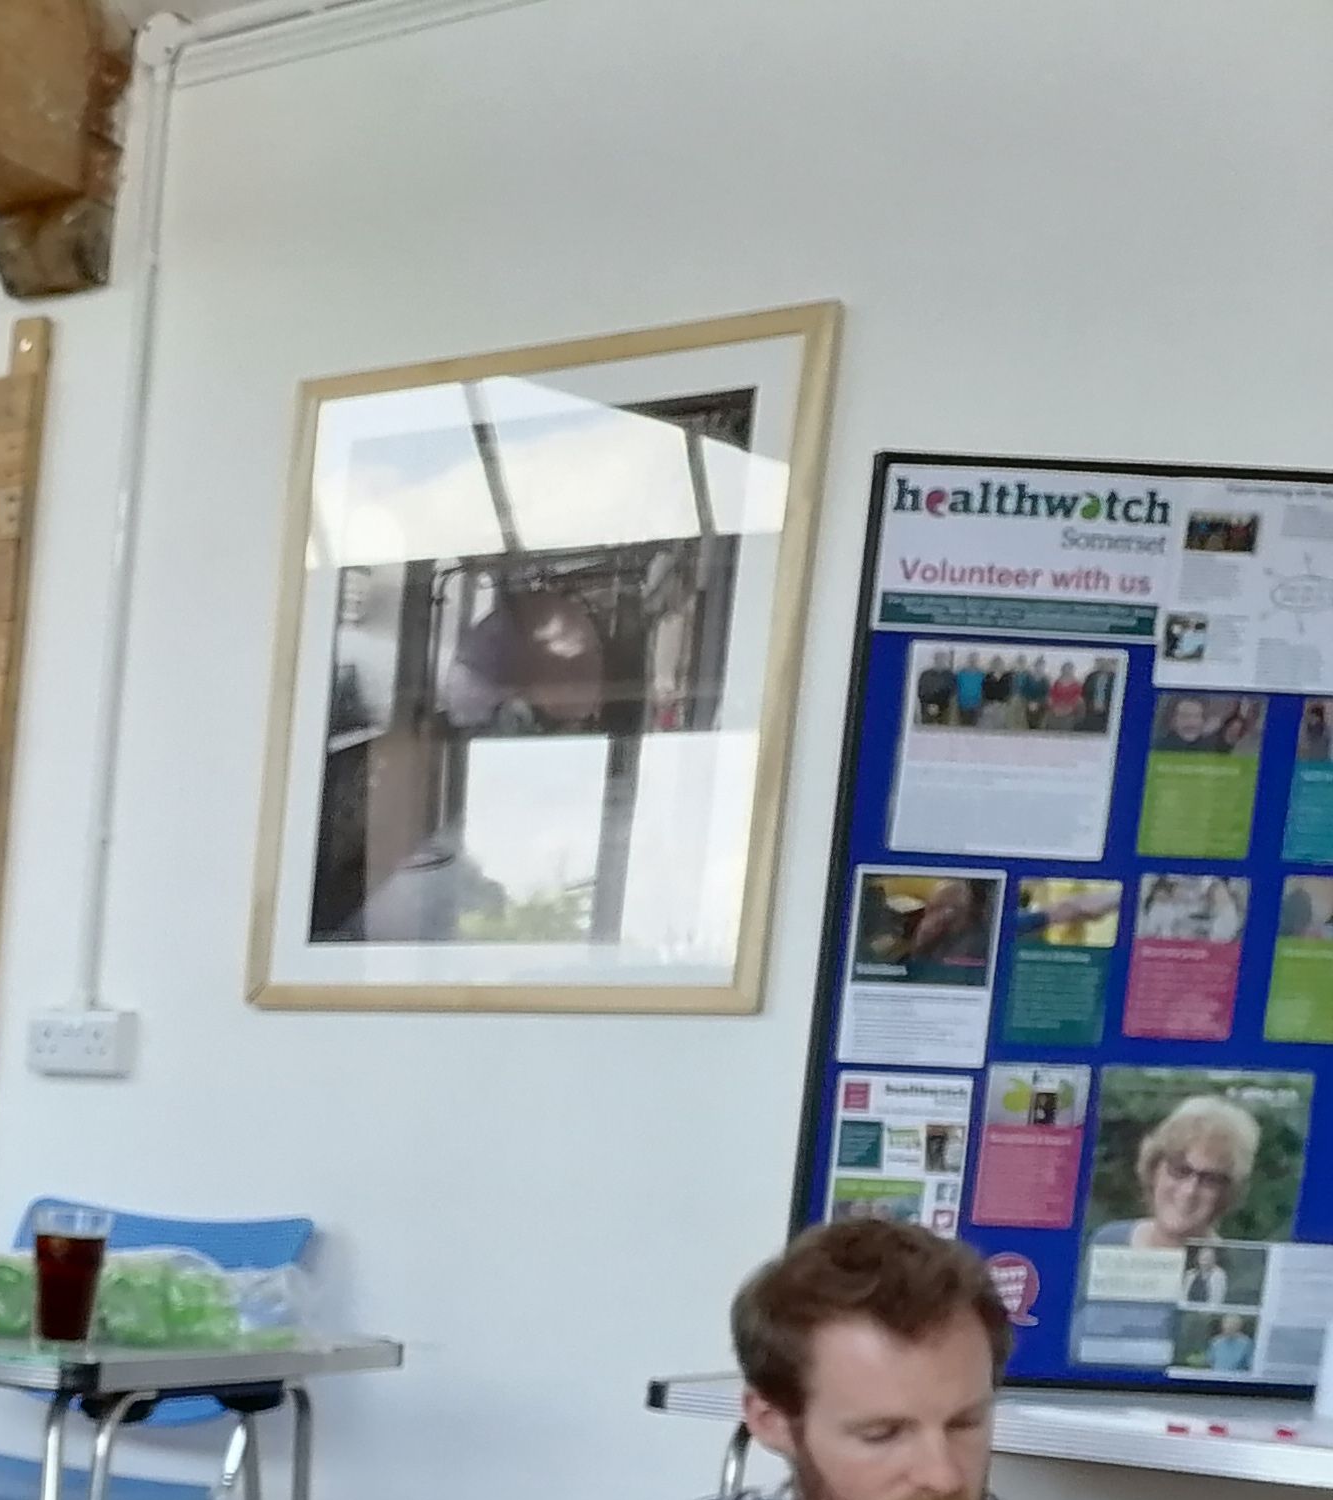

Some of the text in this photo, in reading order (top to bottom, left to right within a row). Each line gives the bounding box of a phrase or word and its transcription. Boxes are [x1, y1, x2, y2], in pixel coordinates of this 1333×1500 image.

[892, 478, 1171, 525] healthwatch
[1060, 525, 1167, 555] Somerset
[899, 556, 1044, 589] Volunteer
[1051, 566, 1111, 592] with
[1117, 574, 1152, 595] us
